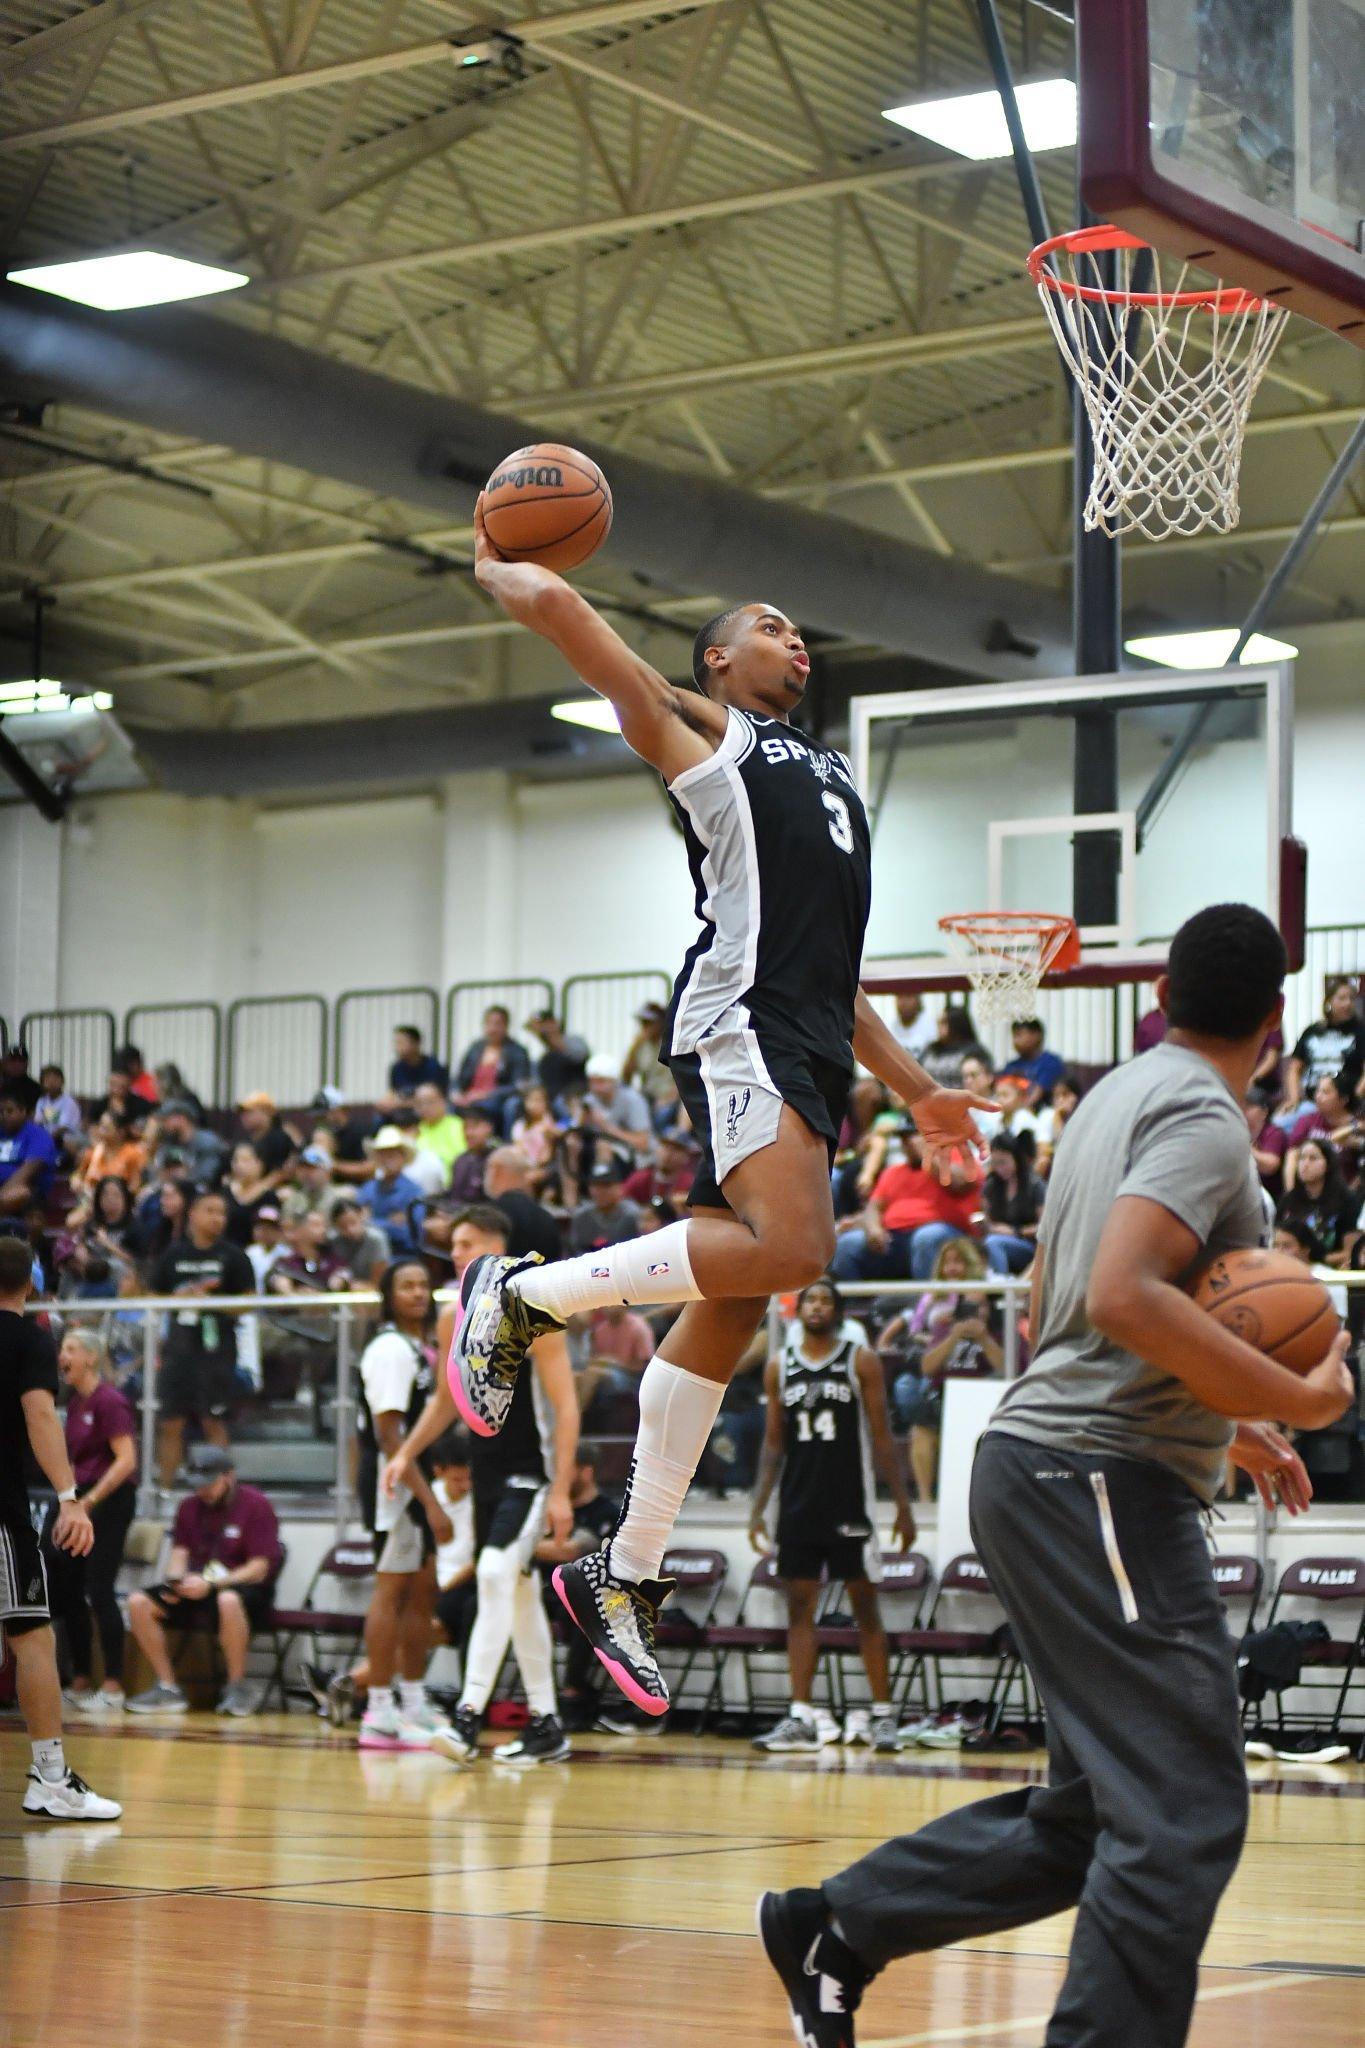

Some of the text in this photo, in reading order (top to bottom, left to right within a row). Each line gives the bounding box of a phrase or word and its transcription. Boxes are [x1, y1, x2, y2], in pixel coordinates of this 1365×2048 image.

[488, 466, 564, 495] Wilson
[821, 790, 855, 854] 3
[796, 1409, 836, 1442] 14
